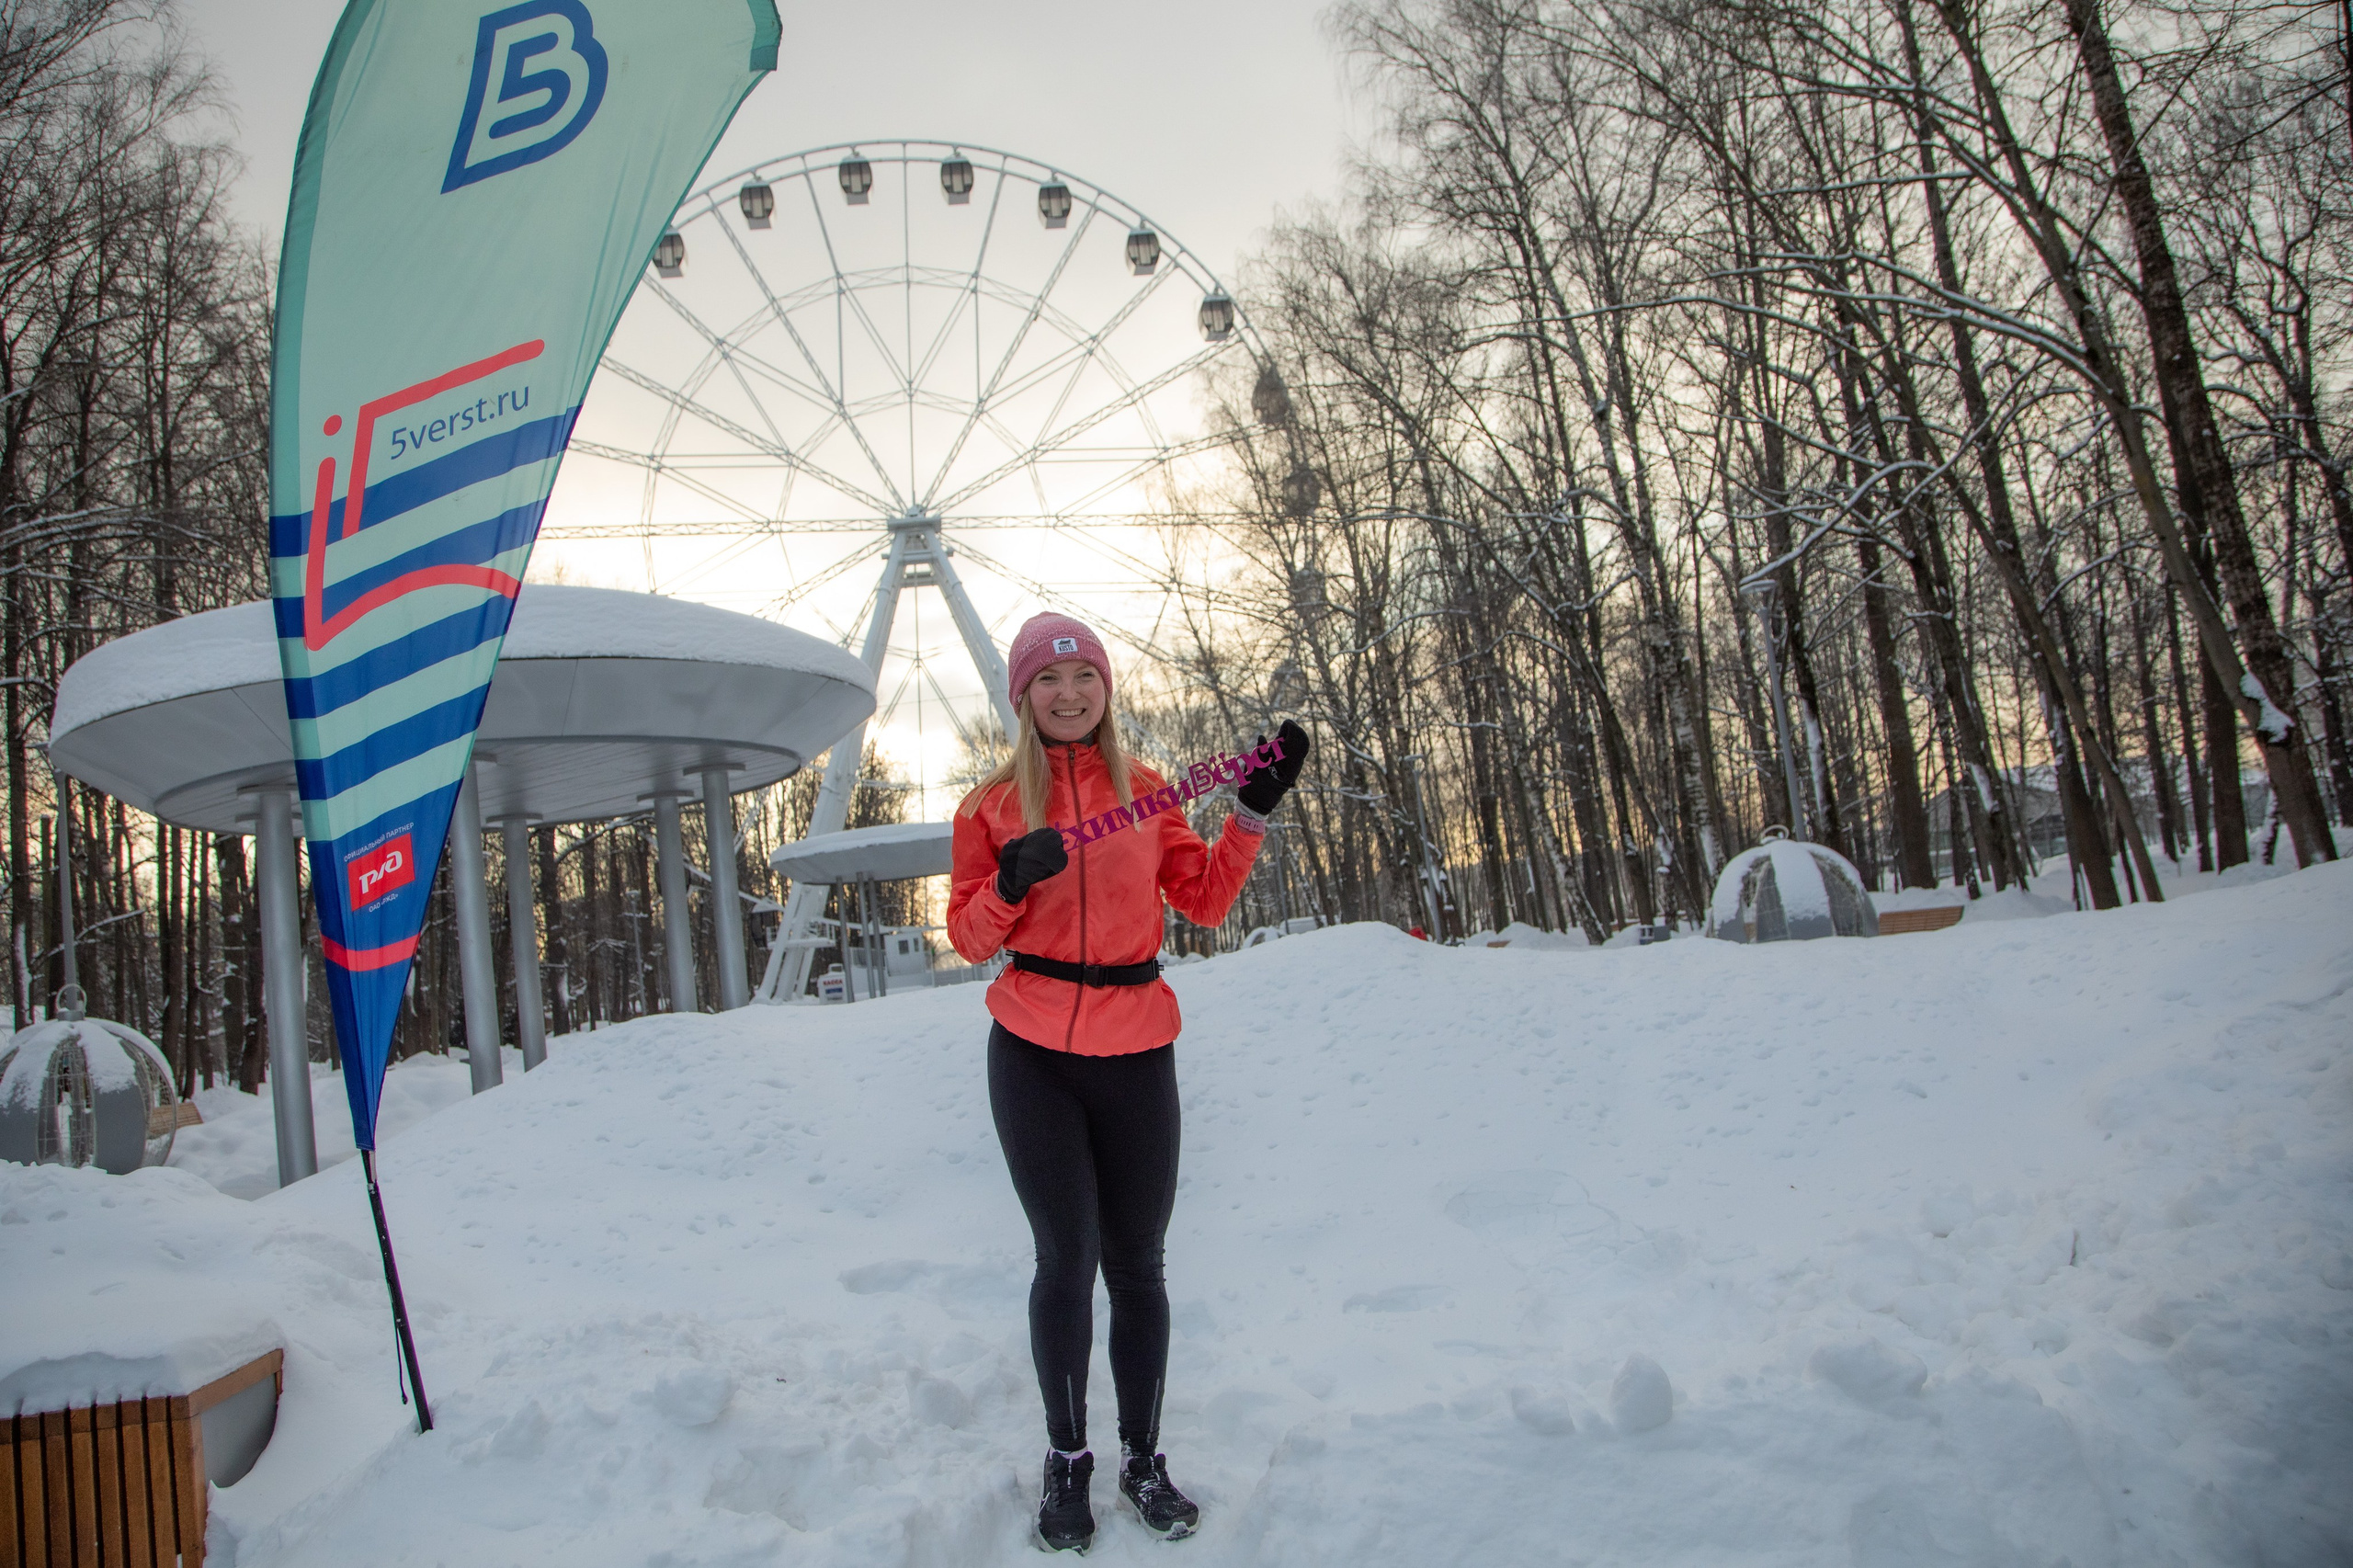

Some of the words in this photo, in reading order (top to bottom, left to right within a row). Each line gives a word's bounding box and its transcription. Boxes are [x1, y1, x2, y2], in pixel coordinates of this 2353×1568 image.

[391, 386, 529, 460] 5verst.ru
[344, 834, 385, 862] ОФИЦИАЛЬНЫЙ
[386, 822, 415, 838] ПАРТНЕР
[369, 902, 381, 913] ОАО
